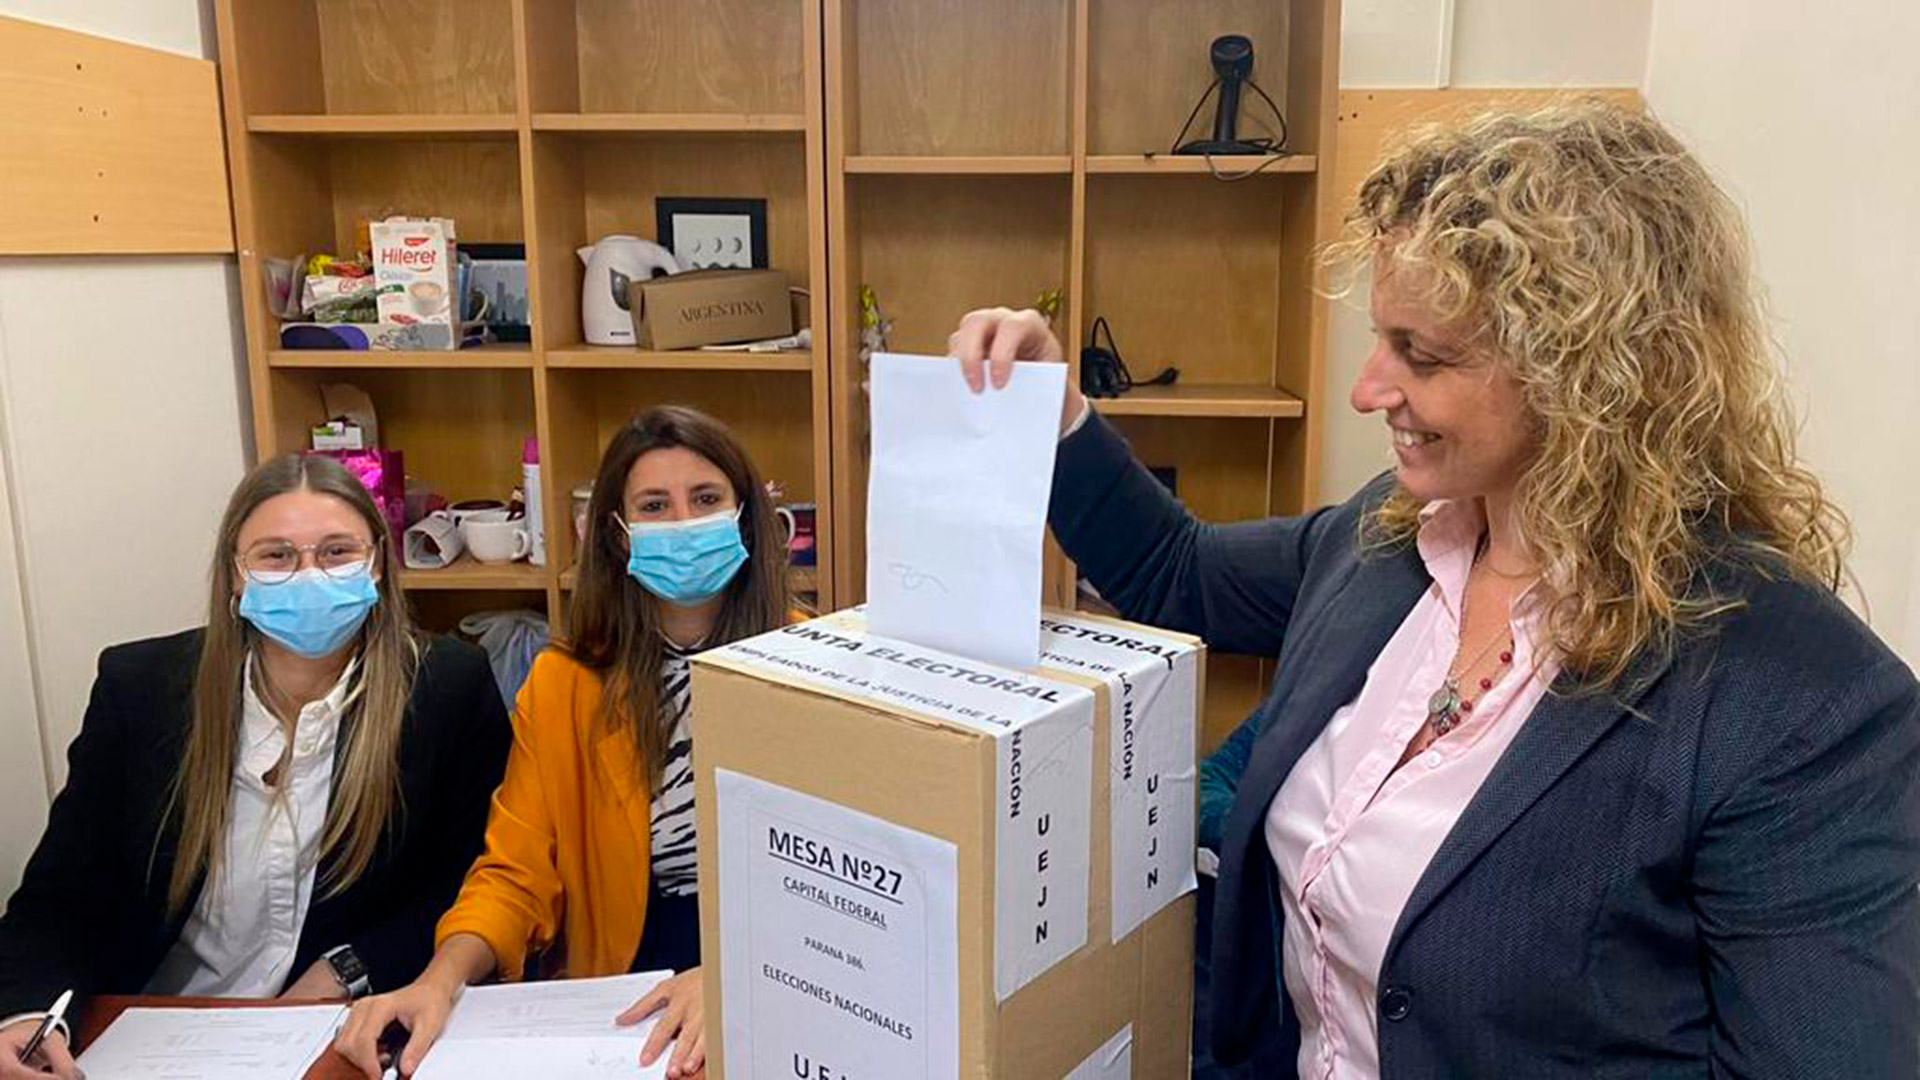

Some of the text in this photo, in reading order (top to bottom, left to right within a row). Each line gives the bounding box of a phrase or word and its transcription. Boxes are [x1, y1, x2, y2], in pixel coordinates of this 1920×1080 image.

[381, 248, 437, 265] Hileret
[678, 300, 765, 323] ARGENTINA
[728, 645, 821, 673] EMPLEADOS
[822, 669, 848, 680] DE
[847, 676, 870, 688] LA
[872, 681, 954, 711] JUSTICIA
[957, 706, 986, 718] DE
[987, 715, 1012, 728] LA
[865, 647, 1060, 703] ELECTORAL
[1089, 663, 1116, 673] DE
[1117, 671, 1133, 697] LA
[768, 826, 835, 873] MESA
[783, 876, 887, 928] CAPITAL FEDERAL
[804, 936, 844, 961] PARANA
[763, 964, 913, 1041] ELECCIONES NACIONALES
